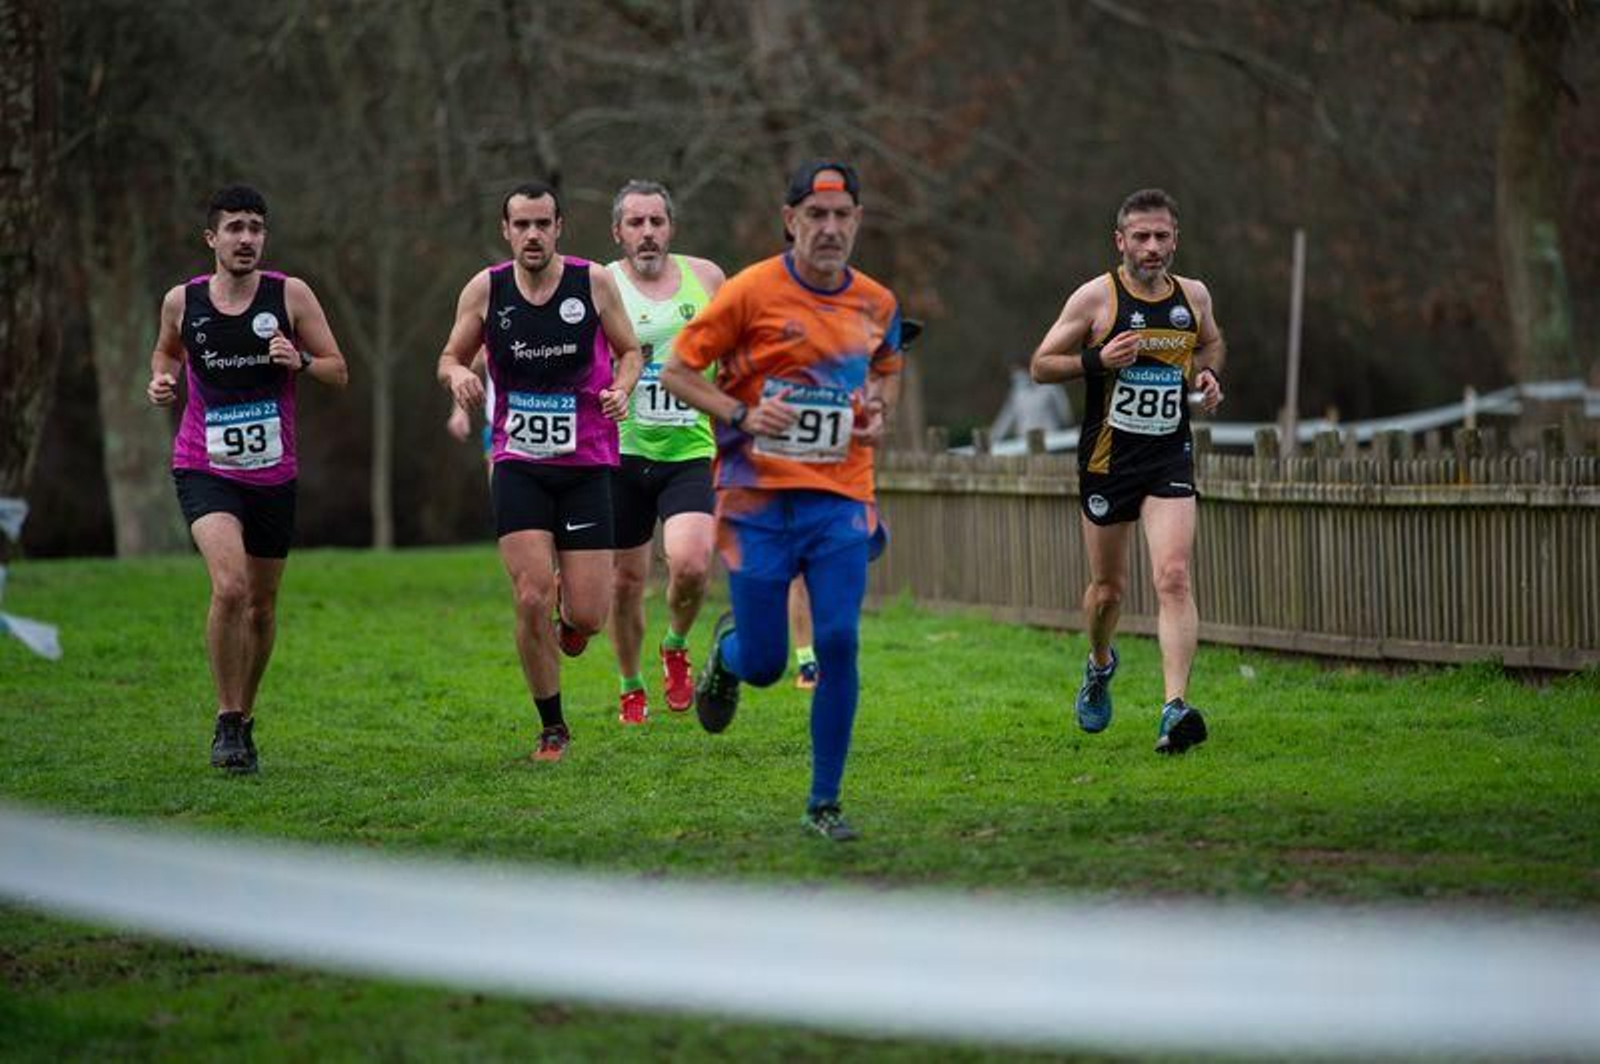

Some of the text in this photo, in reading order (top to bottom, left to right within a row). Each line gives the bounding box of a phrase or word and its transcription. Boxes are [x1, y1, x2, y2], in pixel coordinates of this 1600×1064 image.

[264, 402, 278, 415] 22
[560, 396, 576, 409] 22
[1115, 386, 1178, 419] 286
[223, 424, 267, 456] 93
[510, 413, 571, 445] 295
[768, 409, 841, 446] 91
